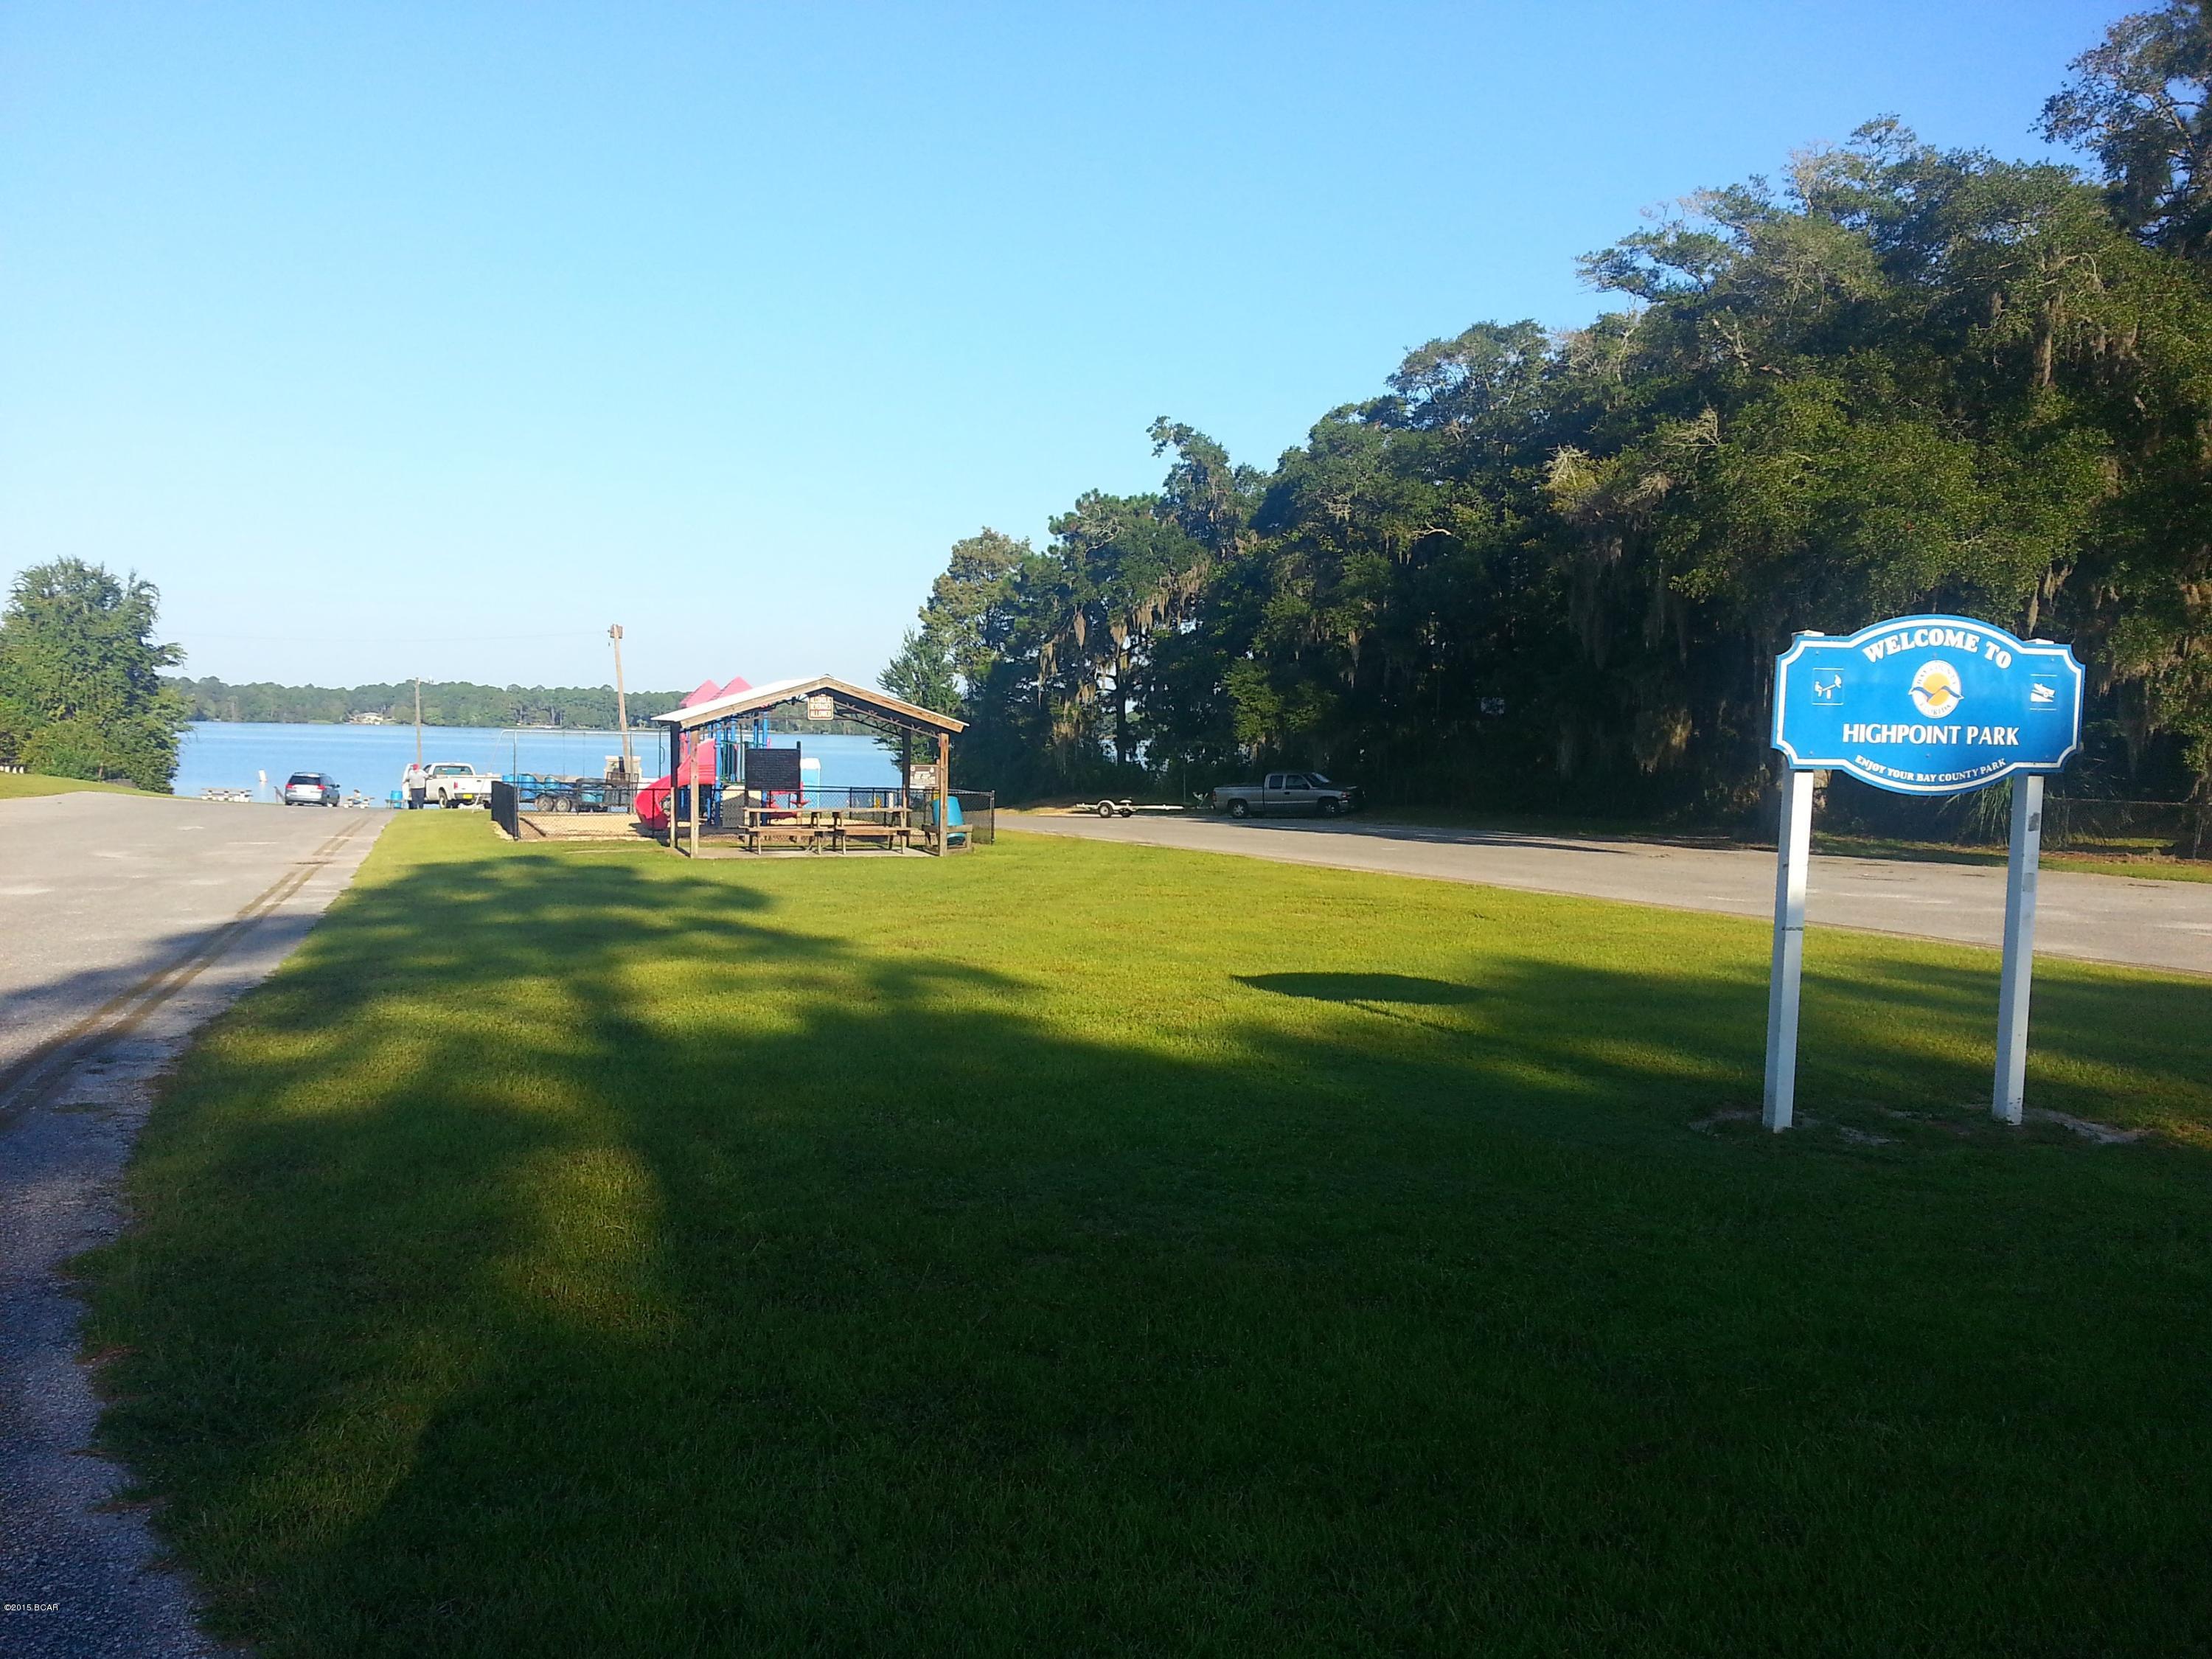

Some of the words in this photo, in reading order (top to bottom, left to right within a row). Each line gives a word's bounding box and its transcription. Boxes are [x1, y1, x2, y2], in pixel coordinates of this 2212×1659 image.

[1862, 628, 1980, 663] WELCOME
[1984, 641, 2012, 669] TO
[1843, 723, 1961, 744] HIGHPOINT
[1966, 726, 2020, 745] PARK
[1854, 754, 1887, 774] ENJOY
[1887, 768, 1915, 781] YOUR
[1916, 773, 1937, 782] BAY
[1938, 768, 1979, 782] COUNTY
[1980, 758, 2006, 775] PARK
